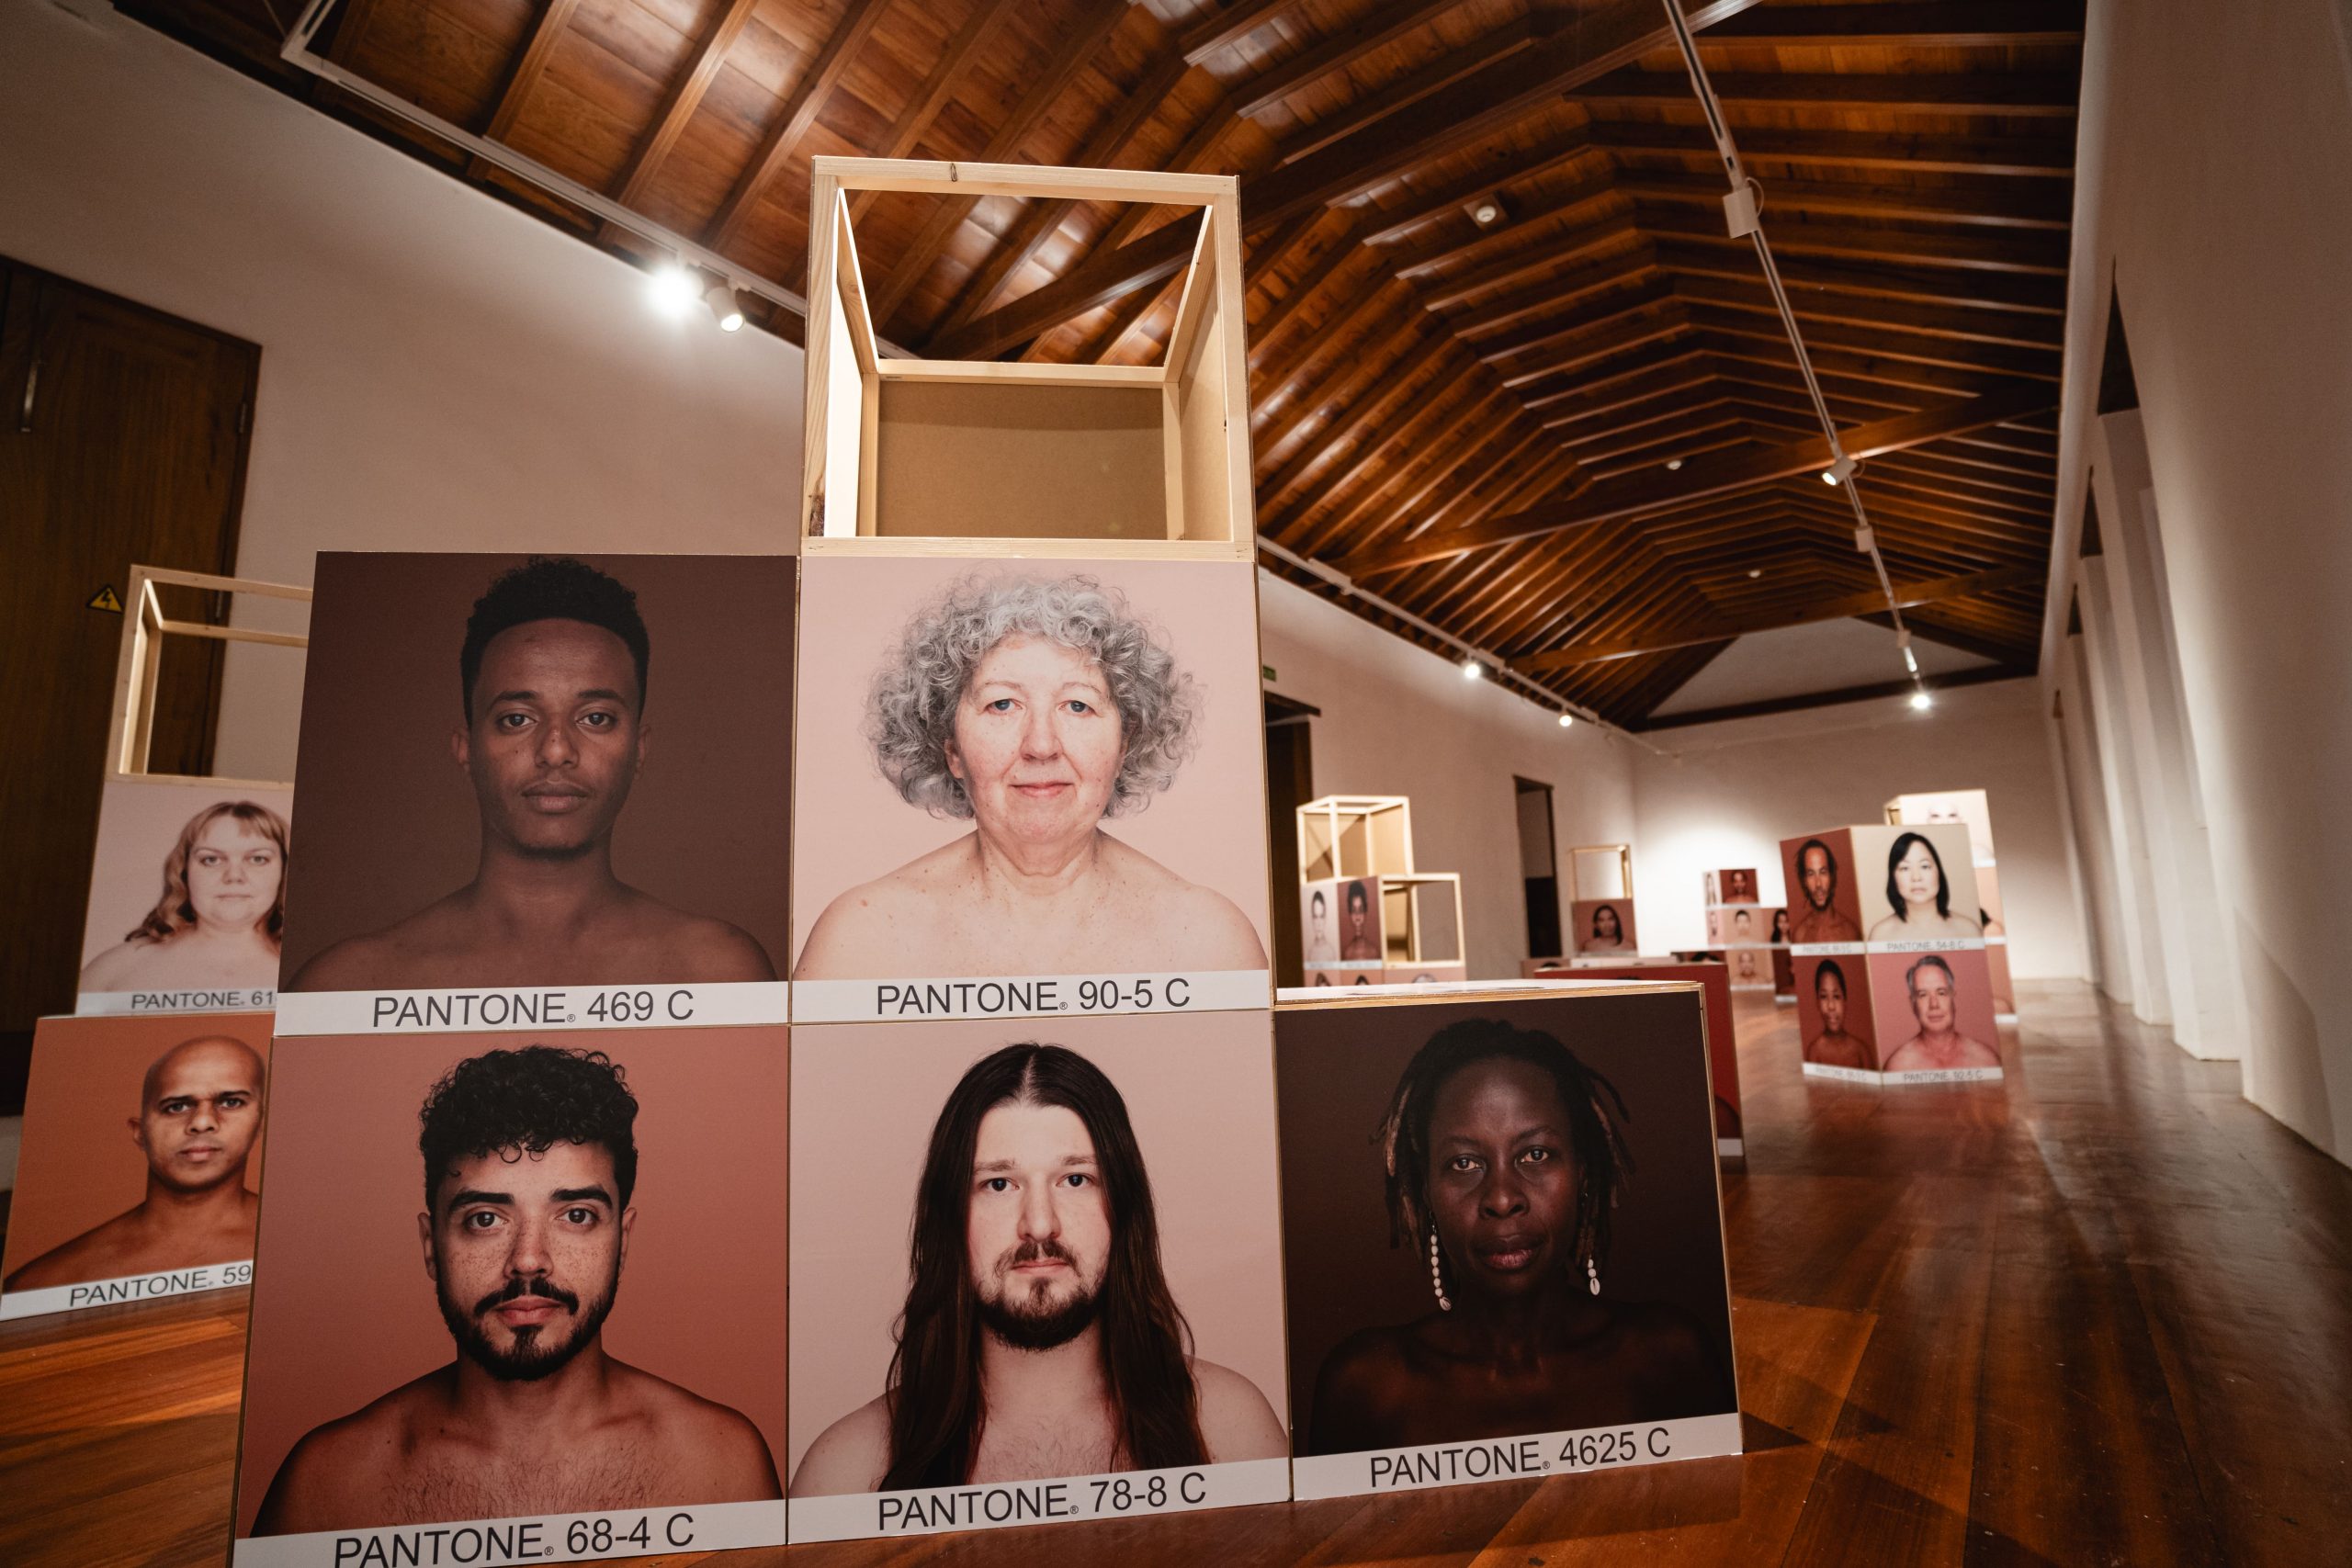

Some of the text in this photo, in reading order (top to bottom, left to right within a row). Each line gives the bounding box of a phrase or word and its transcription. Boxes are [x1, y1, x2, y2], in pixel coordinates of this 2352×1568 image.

[251, 991, 275, 1006] 61
[587, 991, 654, 1022] 469
[667, 989, 694, 1020] C
[1079, 979, 1153, 1010] 90-5
[1165, 977, 1190, 1008] C
[1559, 1430, 1637, 1467] 4625
[1646, 1427, 1671, 1458] C
[1090, 1475, 1168, 1513] 78-8
[1181, 1472, 1206, 1505] C
[566, 1516, 651, 1555] 68-4
[665, 1513, 695, 1547] C
